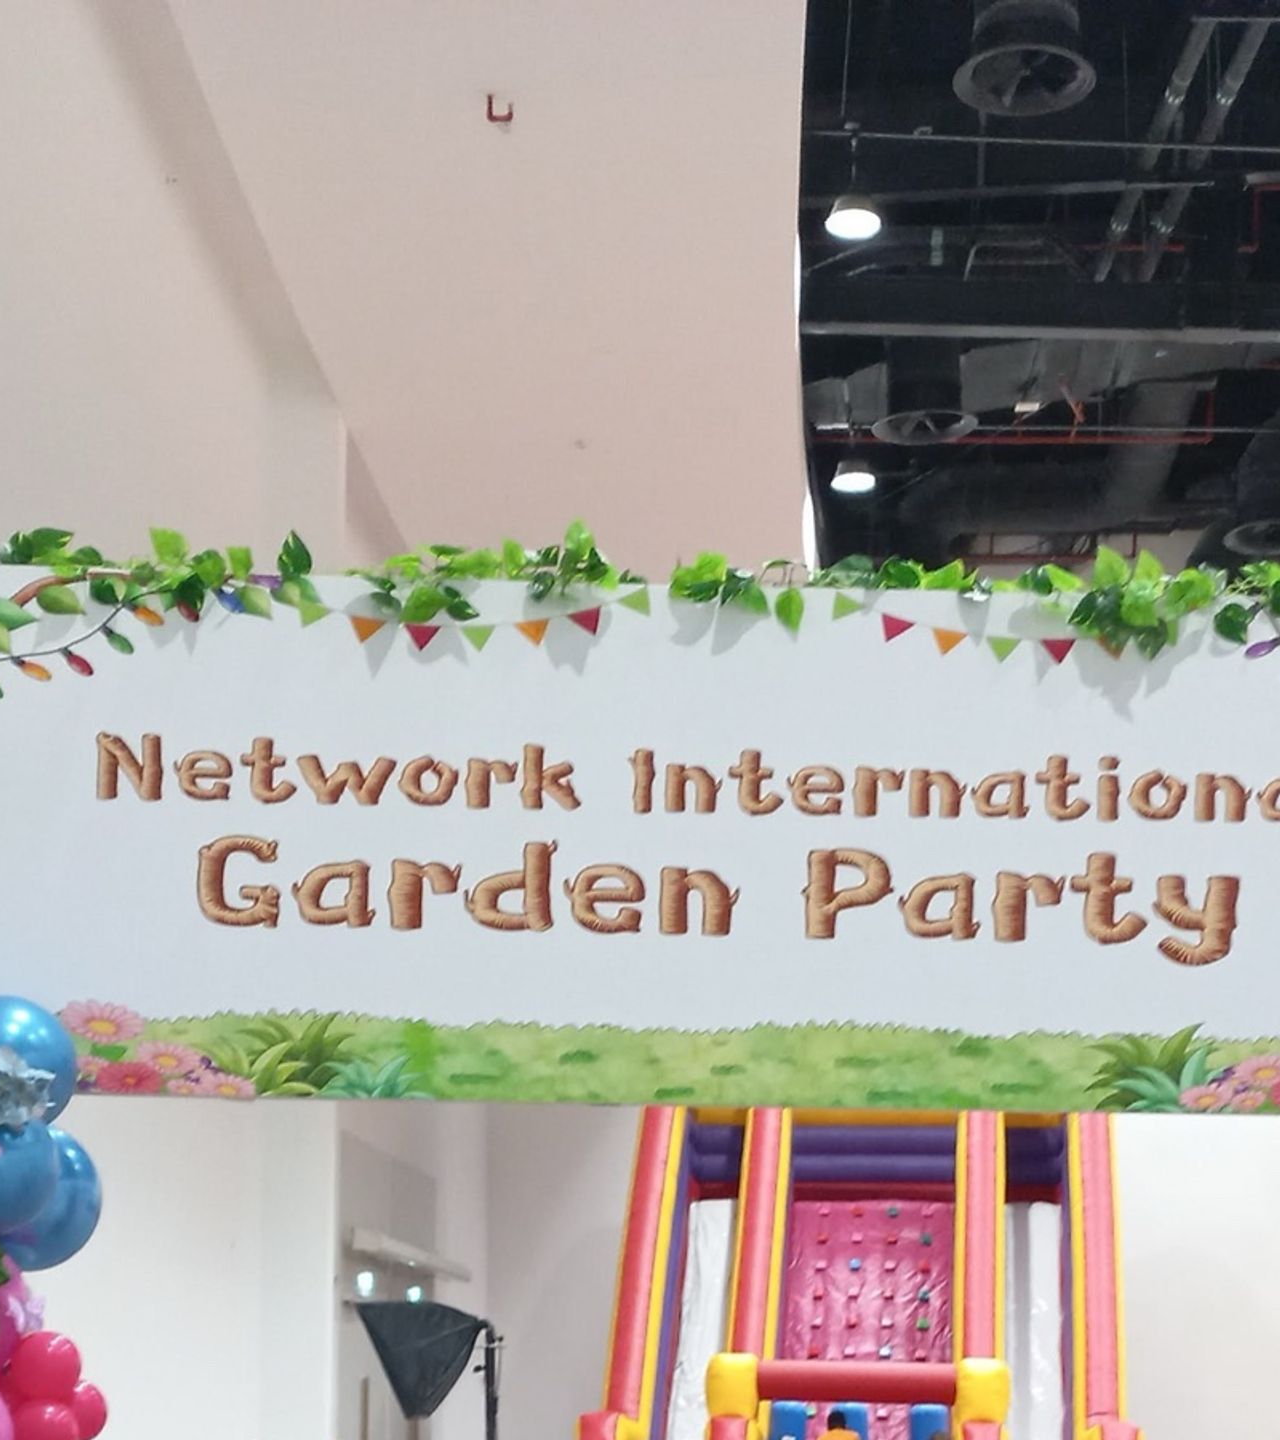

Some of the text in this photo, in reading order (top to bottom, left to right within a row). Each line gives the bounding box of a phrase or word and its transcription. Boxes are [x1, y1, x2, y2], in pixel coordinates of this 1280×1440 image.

[96, 731, 582, 811] Network
[196, 834, 1241, 966] Garden Party
